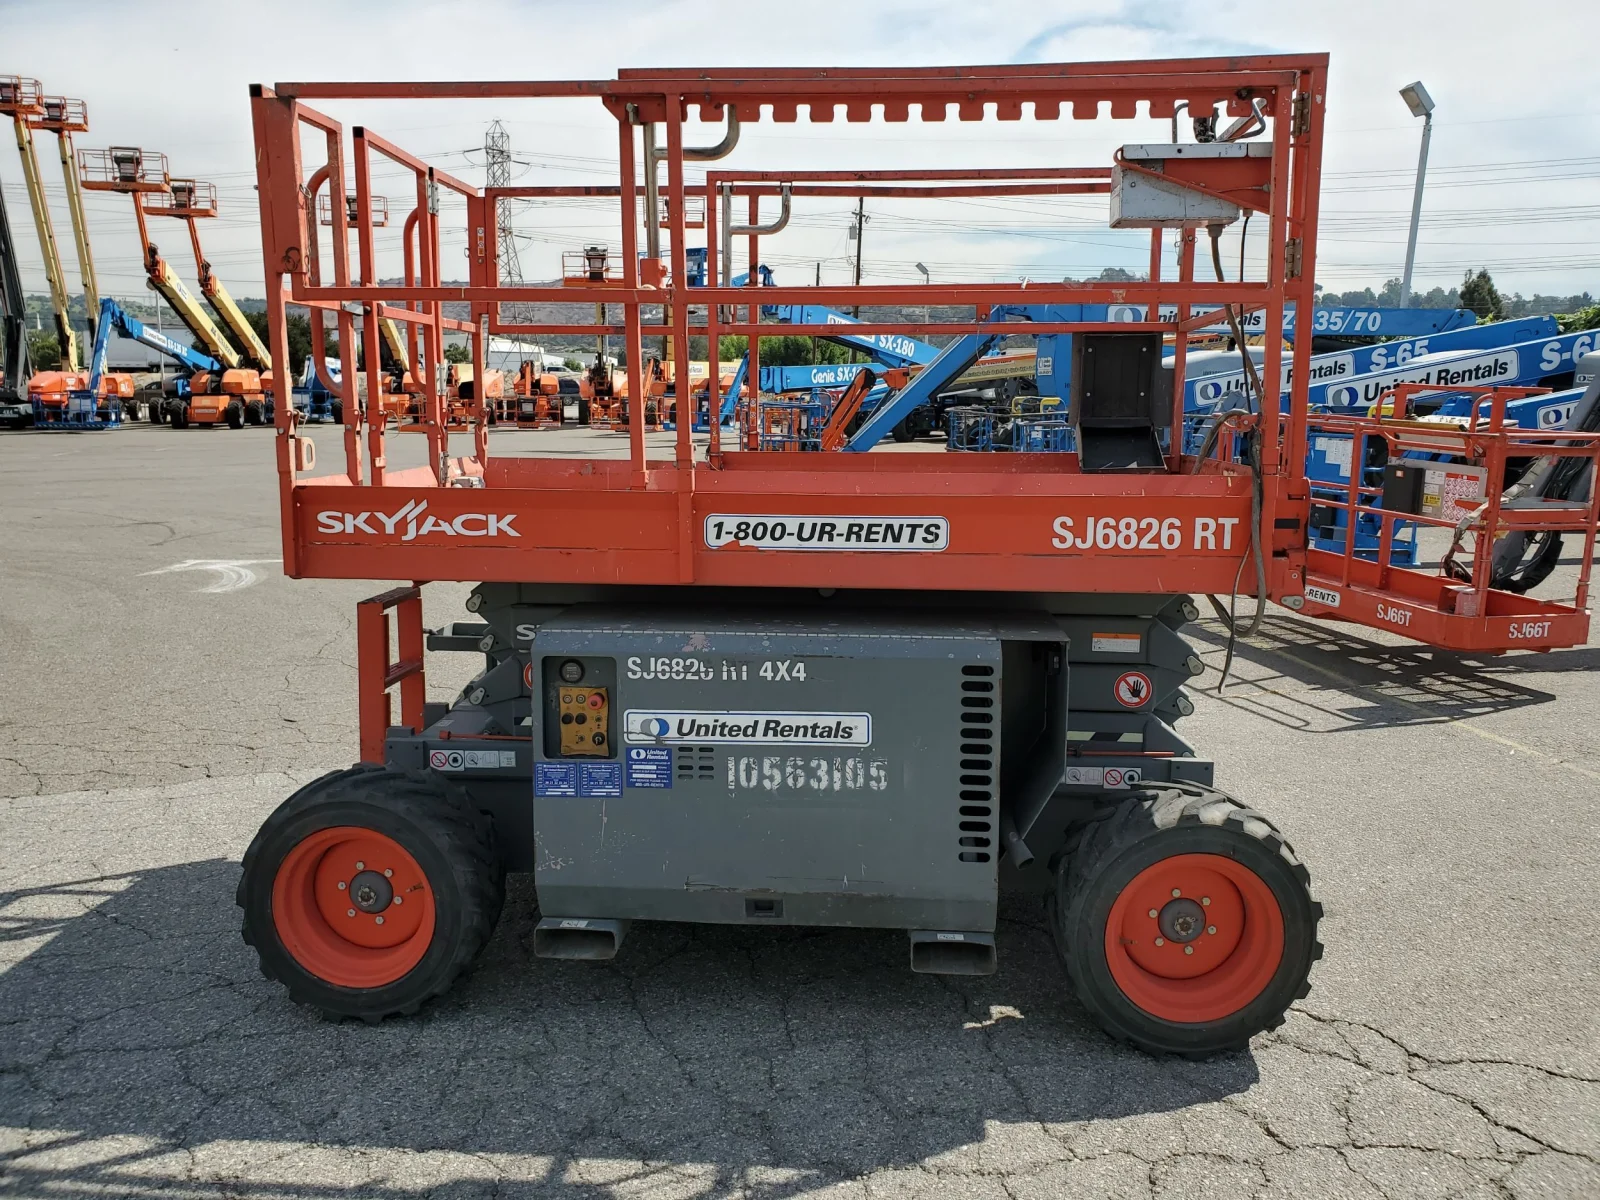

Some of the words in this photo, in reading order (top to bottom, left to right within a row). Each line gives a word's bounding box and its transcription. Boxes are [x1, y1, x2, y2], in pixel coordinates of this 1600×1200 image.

[878, 335, 915, 358] SX-180
[811, 368, 836, 384] Genie
[1436, 358, 1509, 386] Rentals
[317, 498, 523, 541] SKYJACK
[711, 520, 941, 545] 1-800-UR-RENTS
[1051, 516, 1182, 551] SJ6826
[1193, 516, 1240, 550] RT
[1376, 604, 1413, 627] SJ66T
[1508, 621, 1551, 639] SJ66T
[759, 659, 807, 682] 4X4
[677, 718, 759, 738] United
[762, 719, 853, 739] Rentals
[727, 755, 888, 791] 10563105
